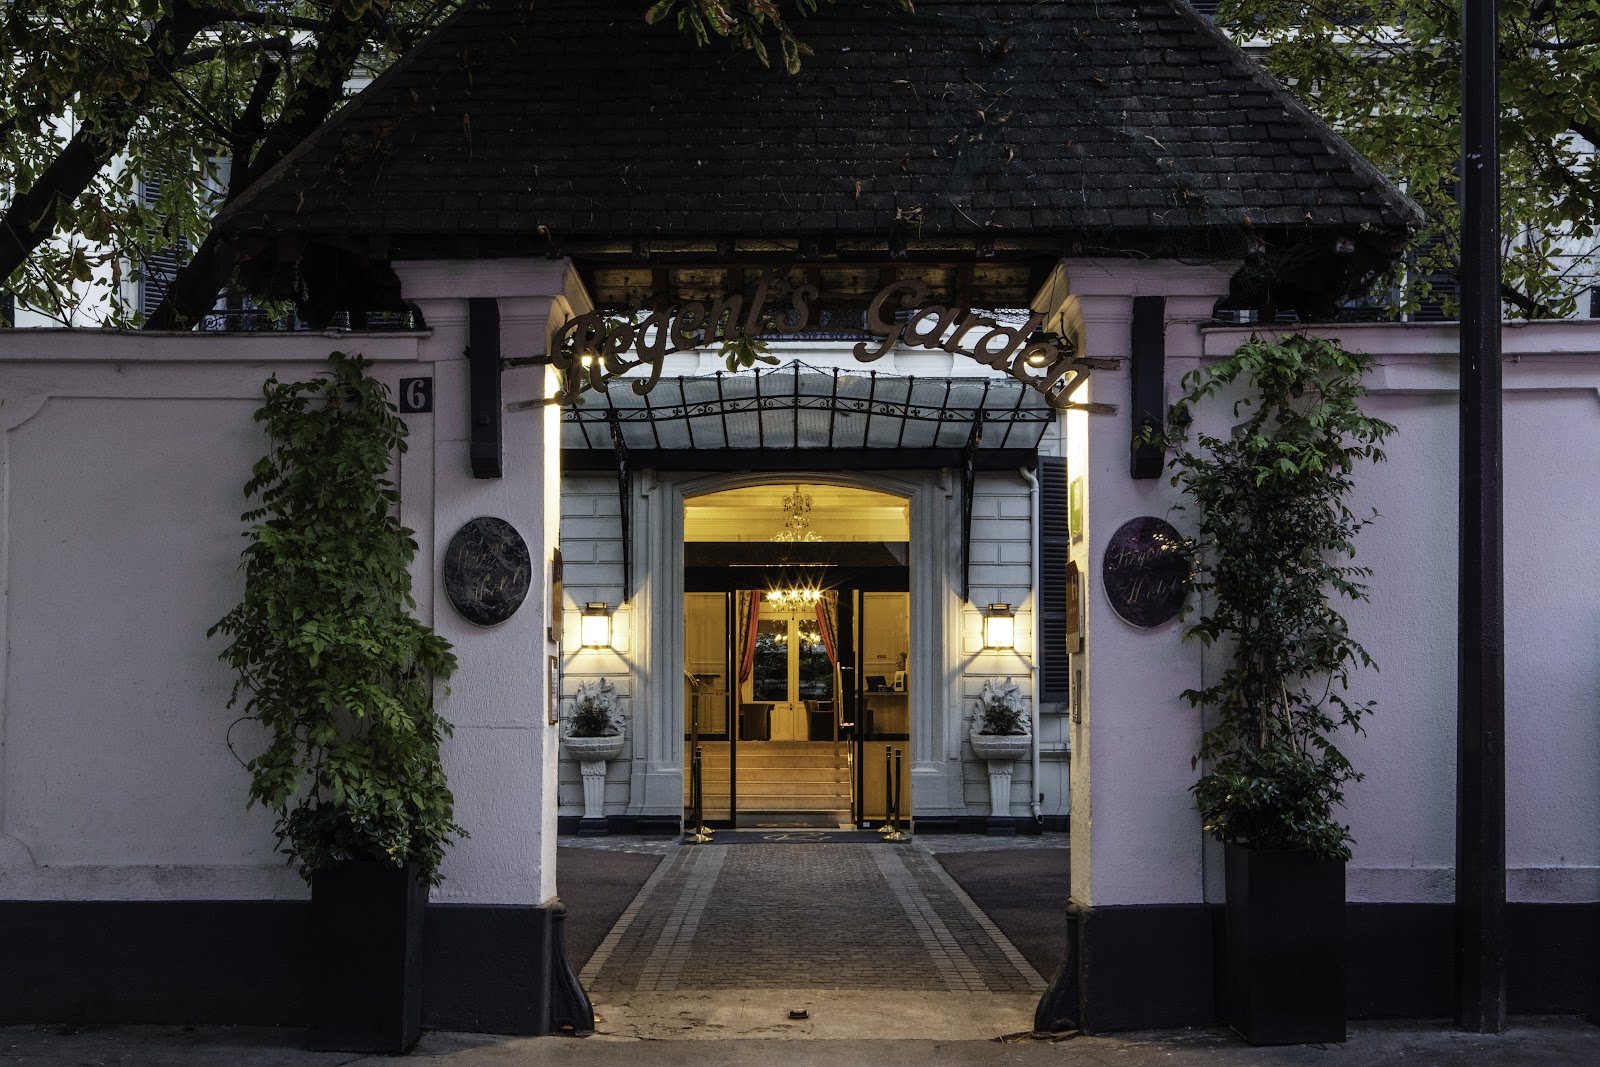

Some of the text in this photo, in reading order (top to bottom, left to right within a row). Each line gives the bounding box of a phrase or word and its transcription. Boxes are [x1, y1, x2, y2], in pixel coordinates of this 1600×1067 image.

[551, 267, 1091, 408] Regent's Garden
[406, 379, 426, 409] 6
